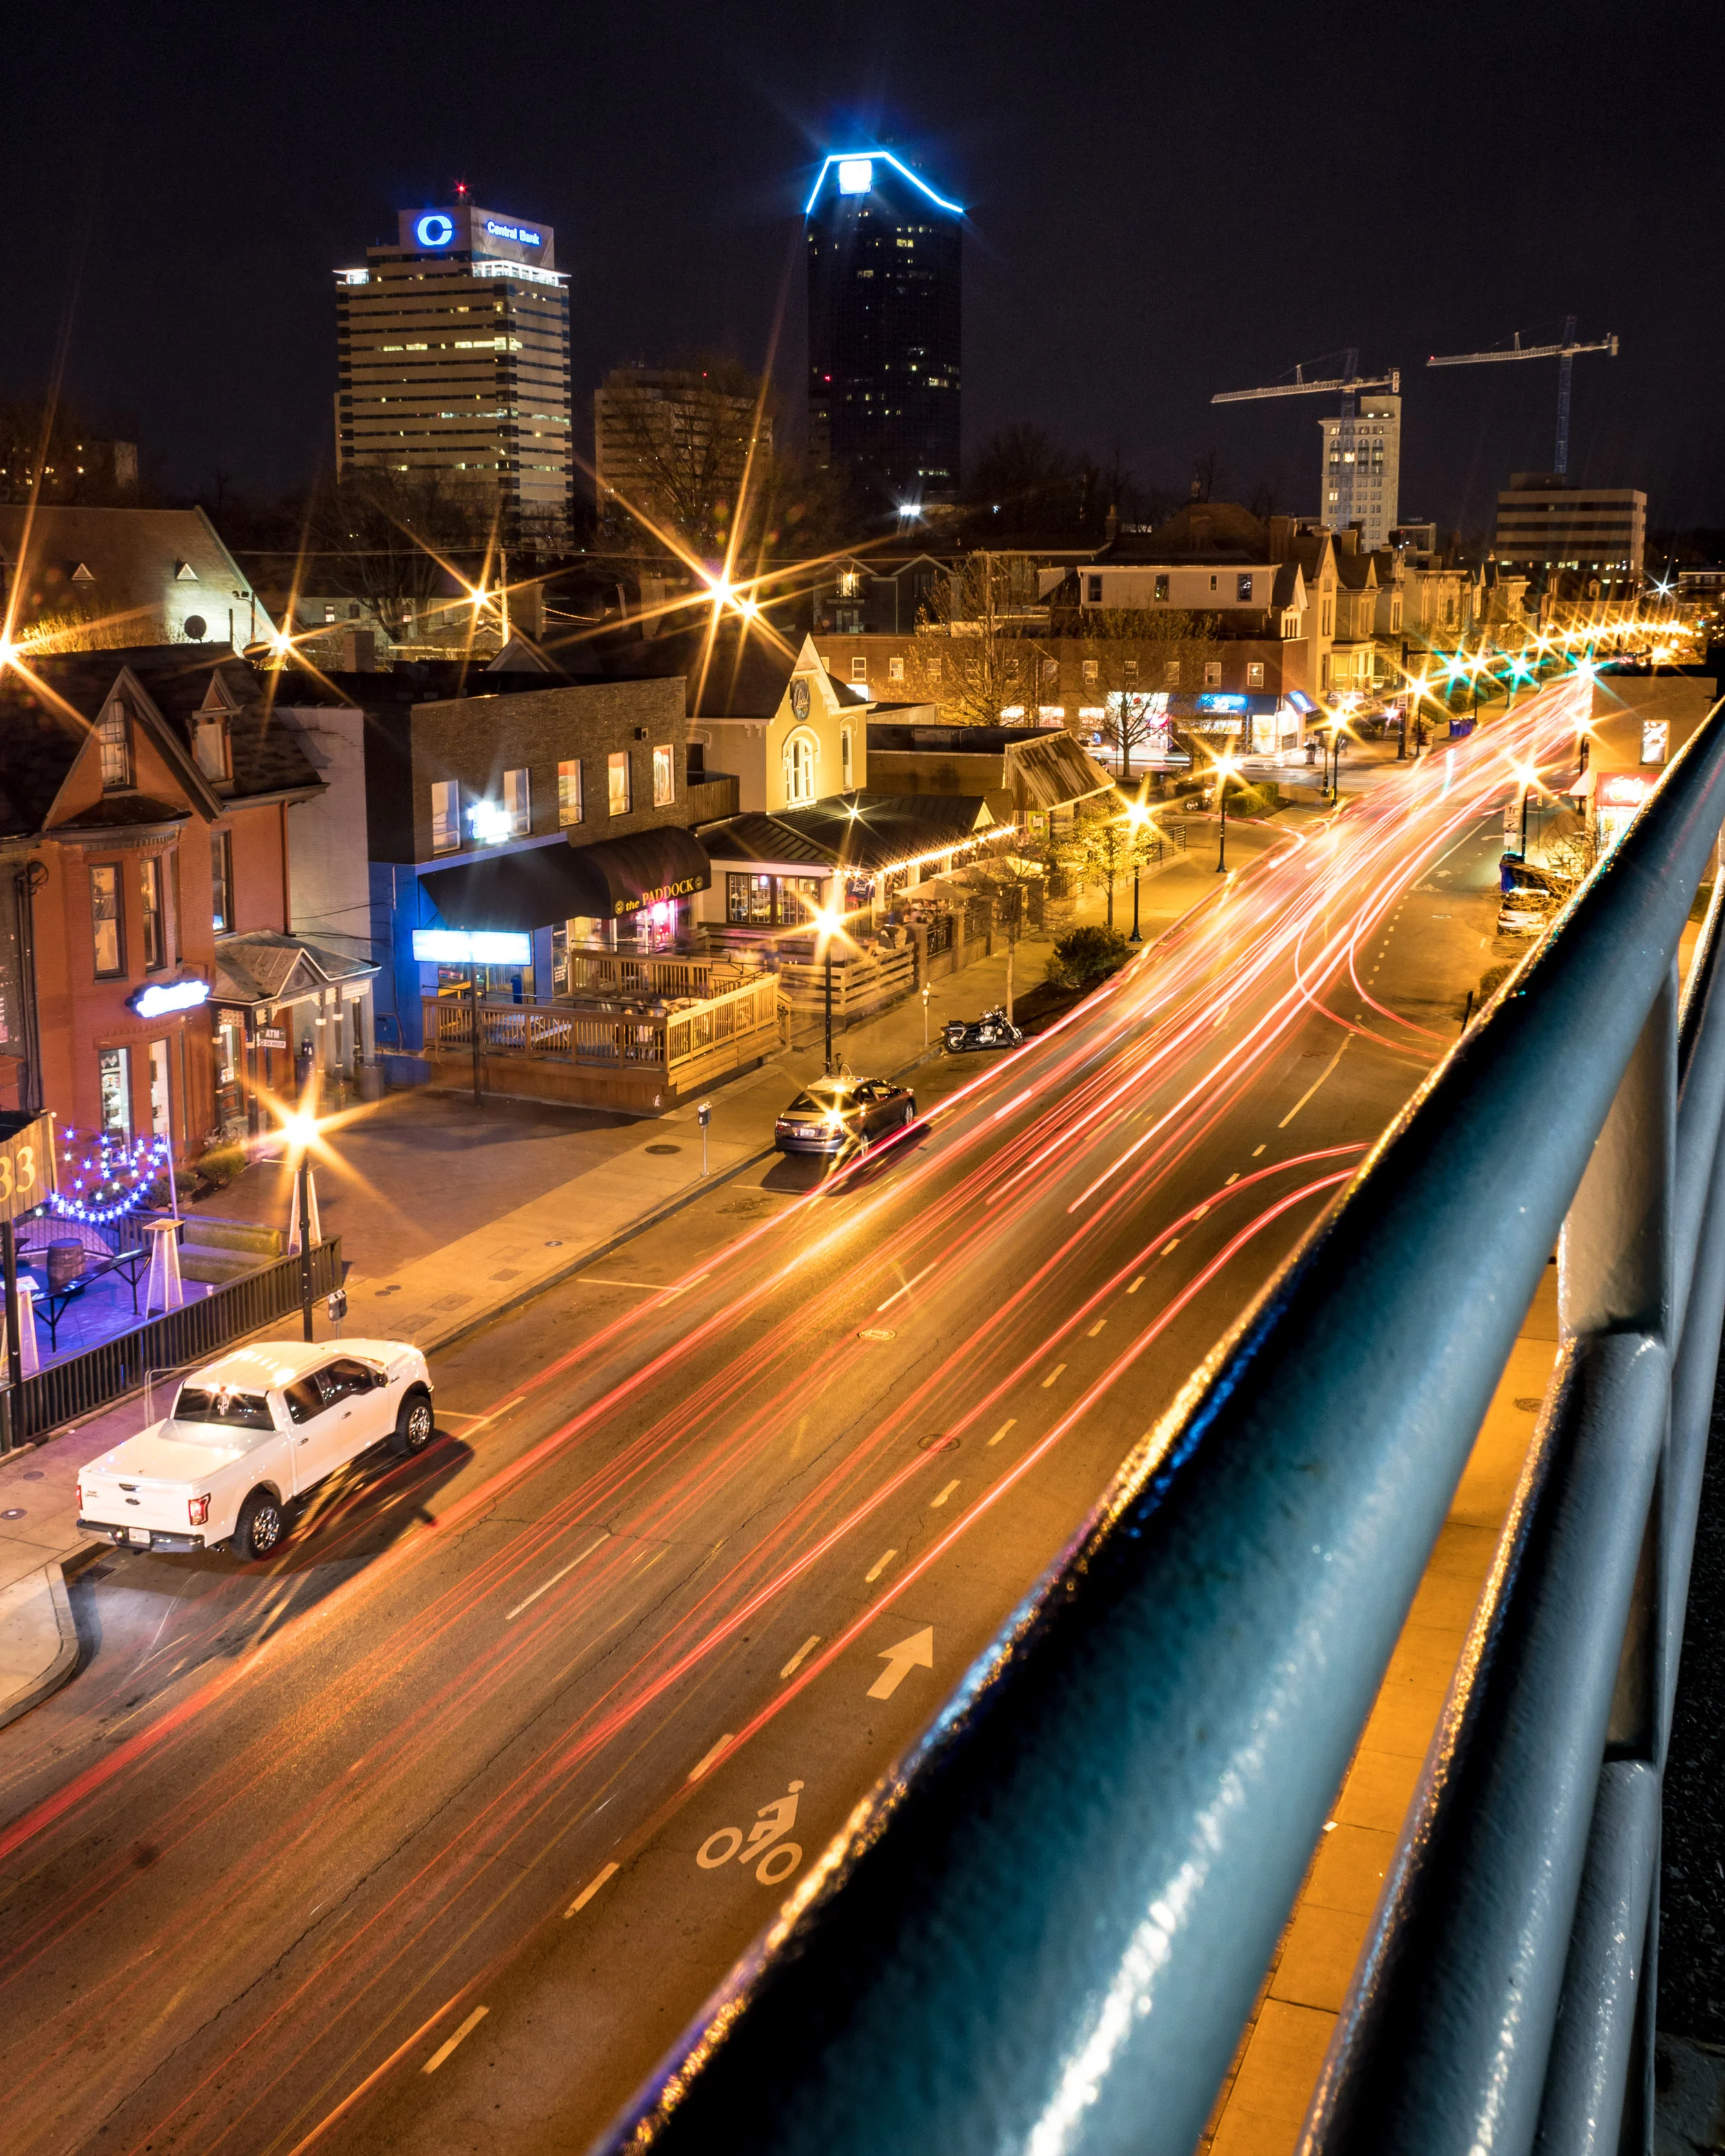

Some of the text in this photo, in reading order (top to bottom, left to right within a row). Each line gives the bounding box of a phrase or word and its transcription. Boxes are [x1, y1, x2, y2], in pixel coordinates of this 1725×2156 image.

[487, 221, 540, 245] Central Bank
[796, 689, 809, 709] Local
[625, 878, 694, 911] the PADDOCK
[851, 882, 867, 892] Local
[265, 1029, 279, 1038] ATM
